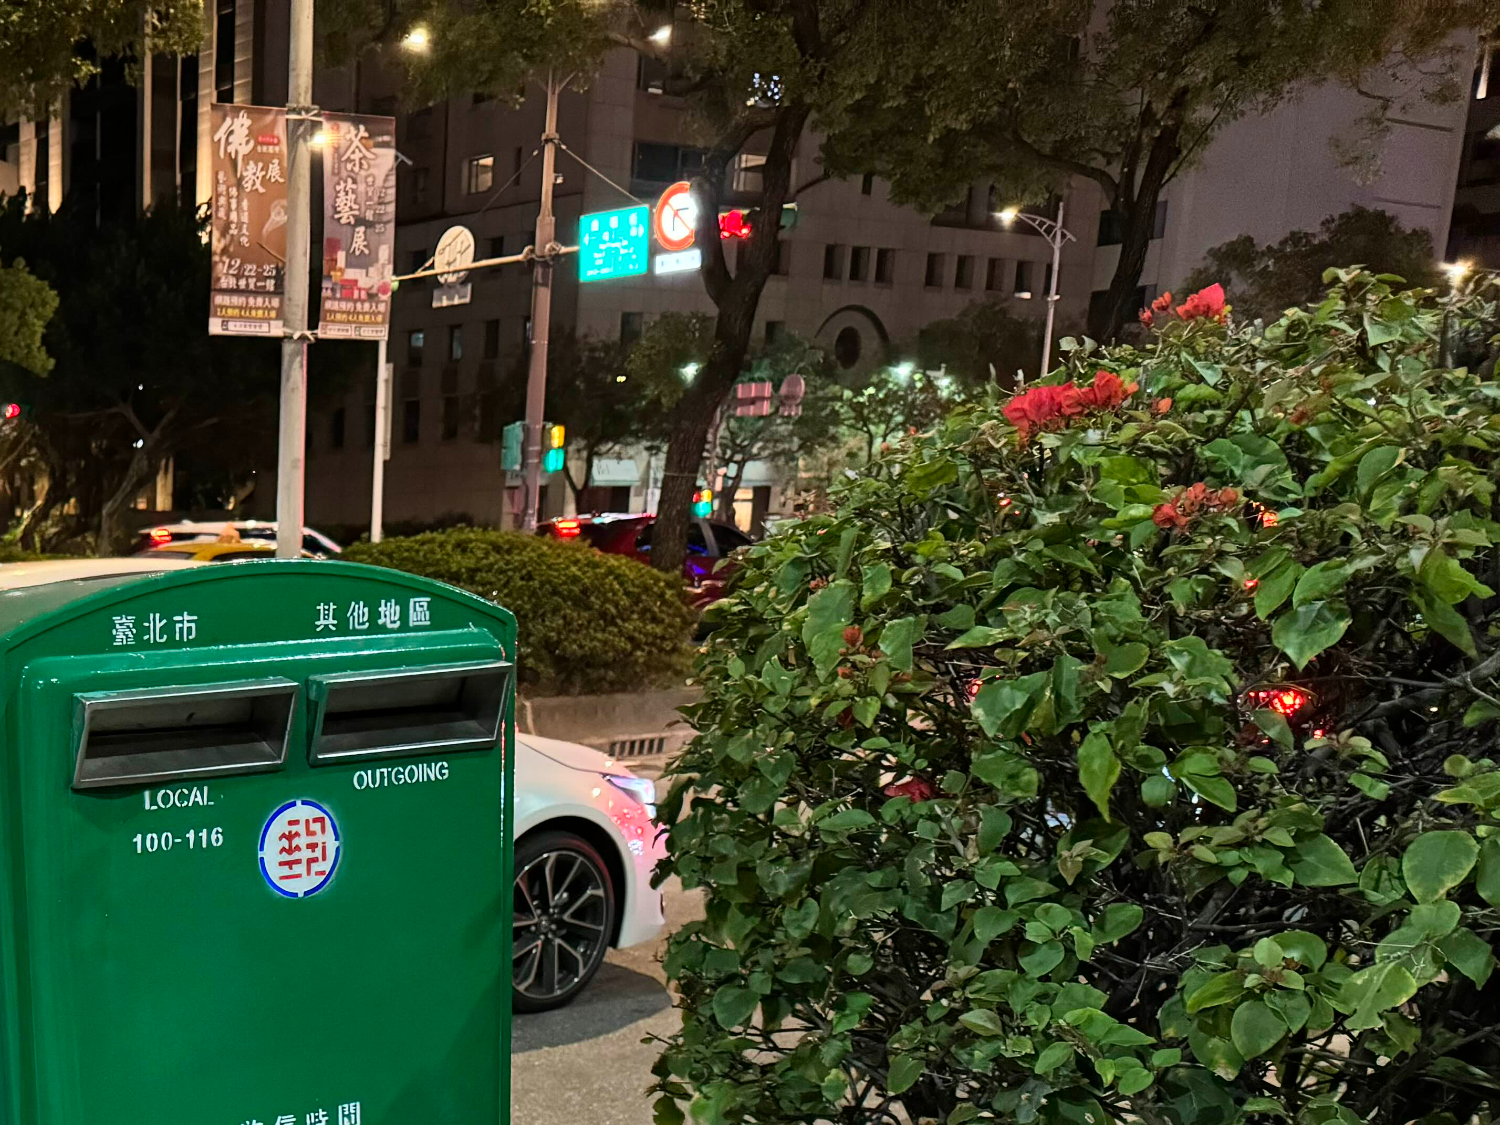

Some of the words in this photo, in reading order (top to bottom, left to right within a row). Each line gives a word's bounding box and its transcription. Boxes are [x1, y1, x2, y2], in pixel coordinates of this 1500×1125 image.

[112, 611, 198, 645] 臺北市
[315, 597, 432, 632] 其他地區
[353, 761, 450, 790] OUTGOING
[144, 785, 215, 811] LOCAL
[133, 826, 225, 854] 100-116
